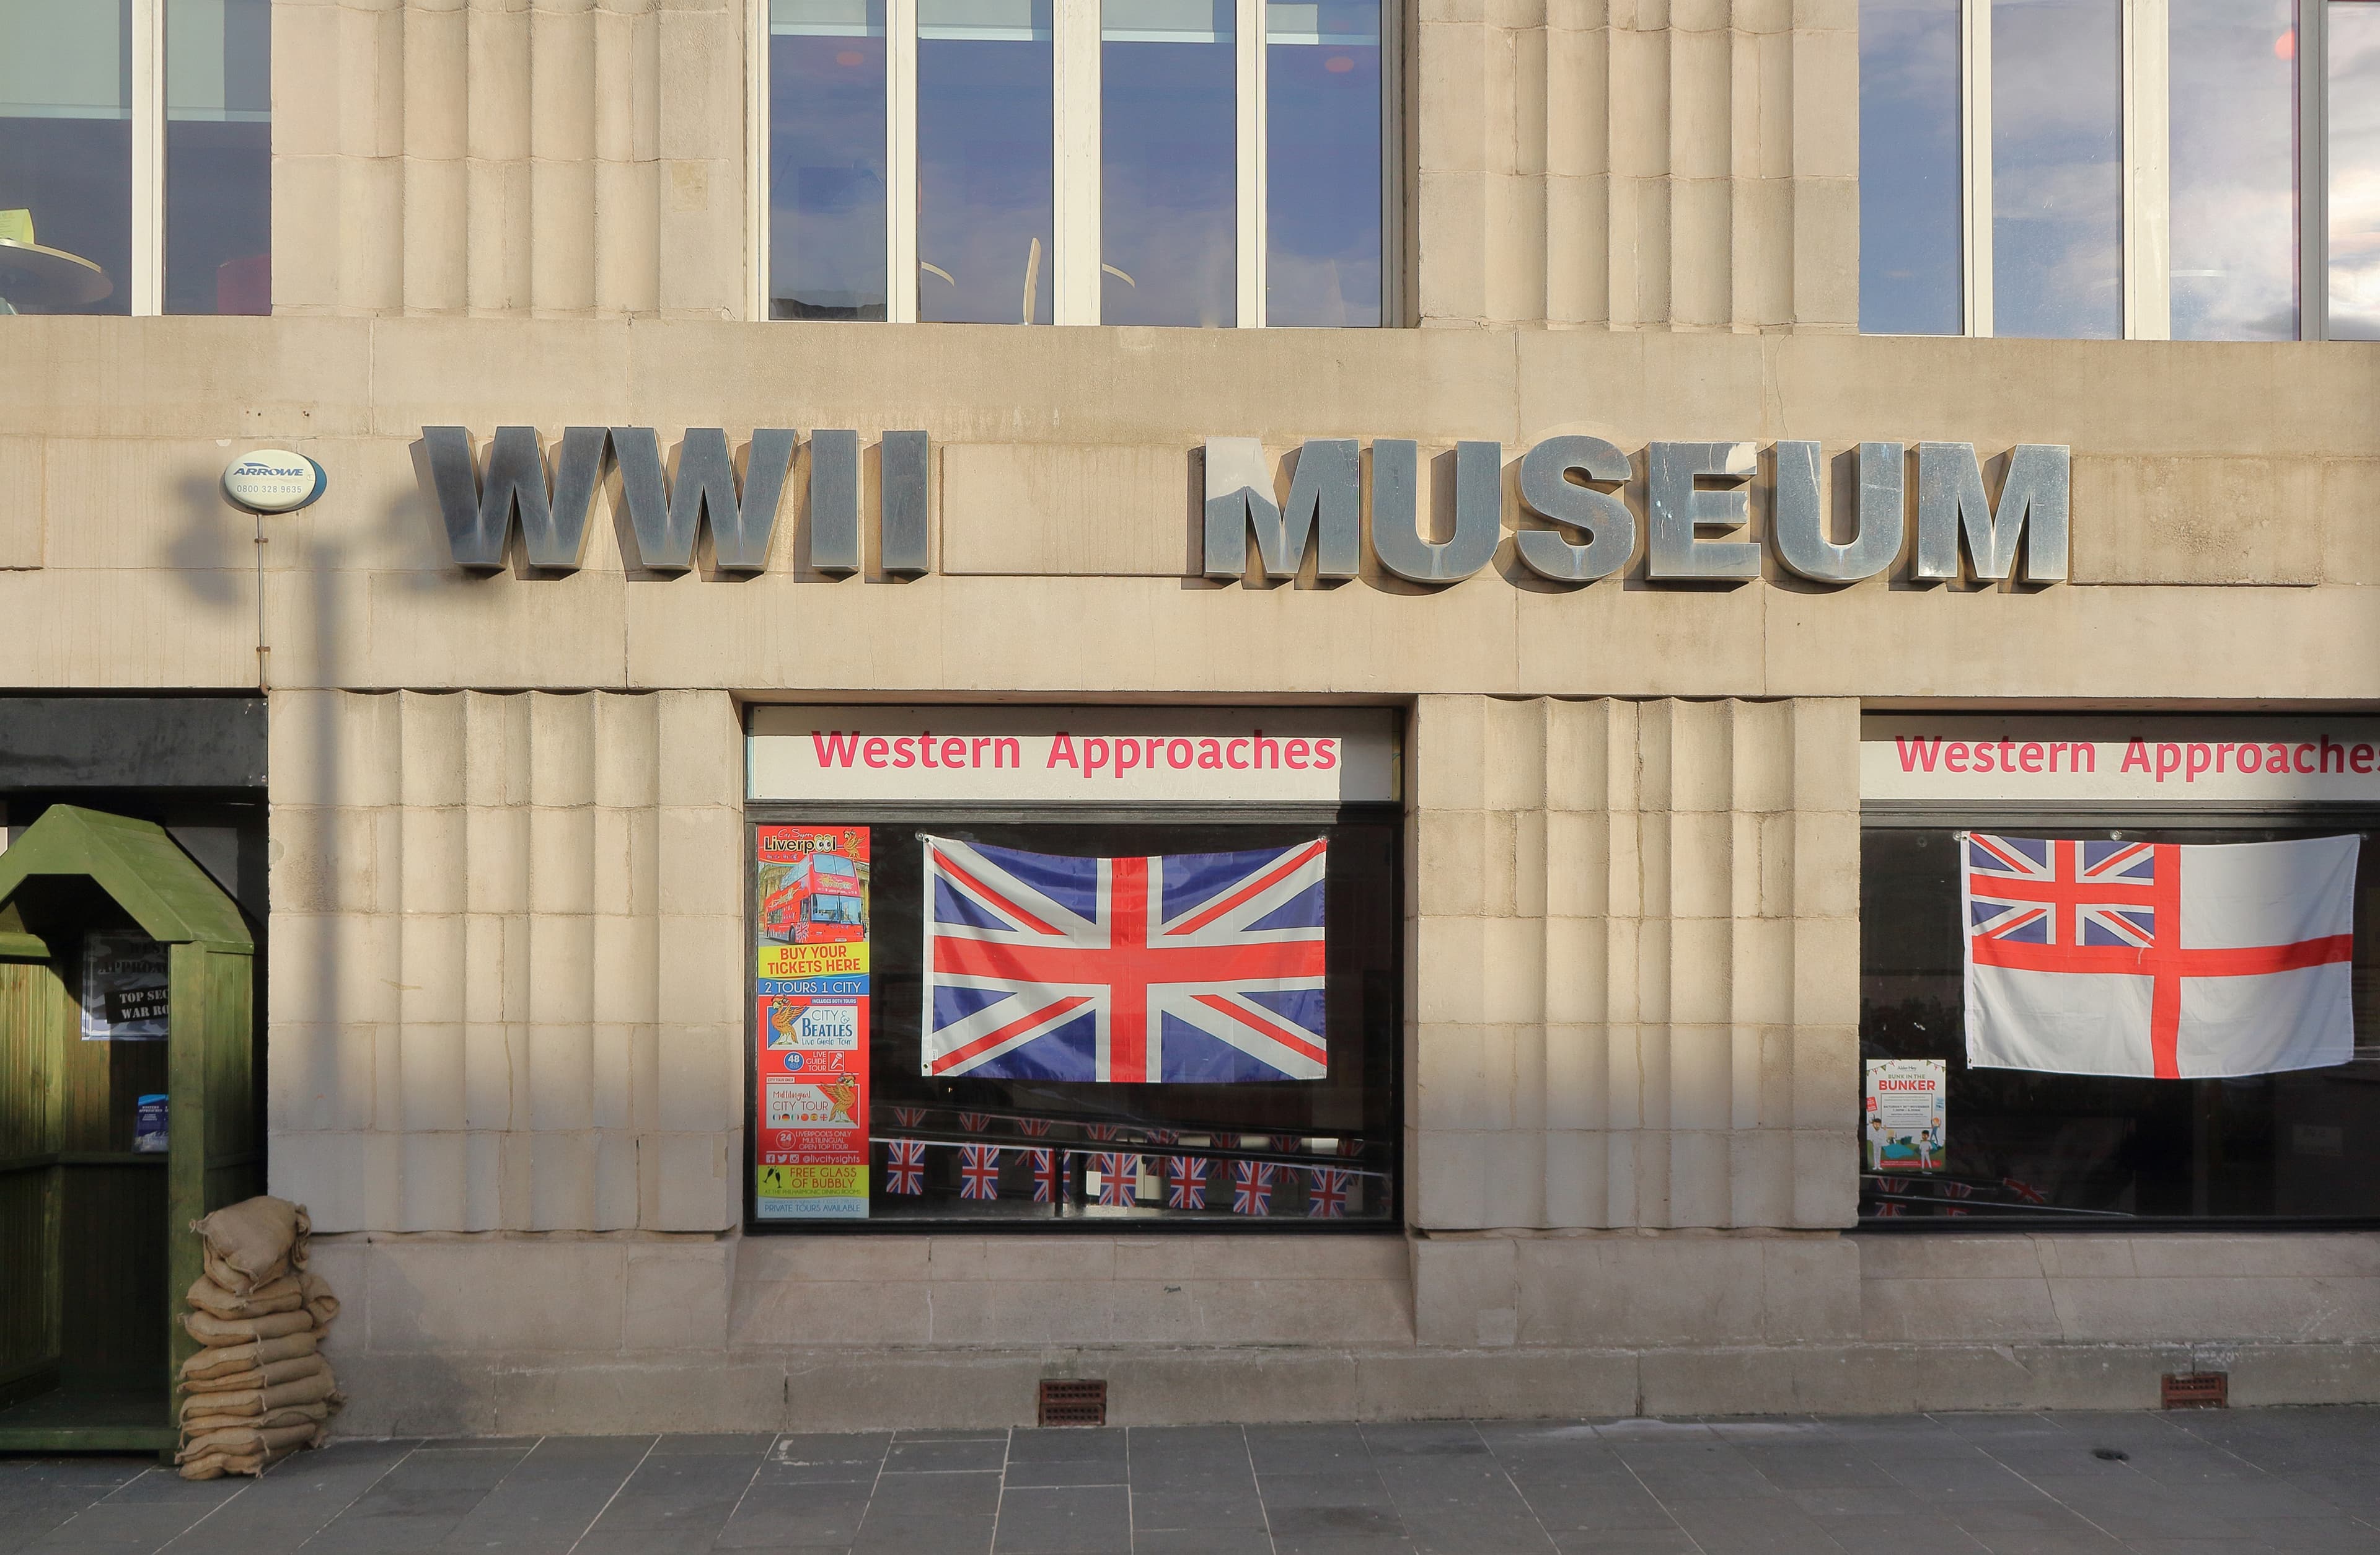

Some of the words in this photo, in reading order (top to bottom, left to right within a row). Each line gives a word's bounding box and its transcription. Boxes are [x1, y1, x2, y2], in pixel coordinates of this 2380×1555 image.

[233, 467, 304, 476] ARROWE
[237, 485, 258, 493] 0800
[262, 485, 278, 493] 328
[281, 485, 302, 493] 9635
[421, 426, 930, 573] WWII
[1205, 435, 2070, 584] MUSEUM
[811, 730, 1020, 769] Western
[1046, 729, 1336, 778] Approaches
[1895, 735, 2096, 773] Western
[2120, 734, 2380, 783] Approache
[764, 834, 837, 855] Liverpool
[780, 947, 808, 961] BUY
[811, 945, 847, 959] YOUR
[767, 960, 822, 975] TICKETS
[826, 958, 861, 972] HERE
[764, 982, 772, 993] 2
[776, 982, 818, 993] TOURS
[821, 982, 829, 993] 1
[832, 982, 862, 993] CITY
[120, 992, 144, 1004] TOP
[122, 1007, 150, 1020] WAR
[811, 1010, 839, 1021] CITY
[840, 1010, 850, 1024] &
[802, 1018, 853, 1037] BEATLES
[802, 1037, 814, 1046] Live
[816, 1037, 834, 1046] Guide
[838, 1037, 852, 1046] Tour
[788, 1055, 800, 1063] 48
[1879, 1080, 1936, 1090] BUNKER
[773, 1091, 811, 1101] Multilingual
[772, 1101, 796, 1111] CITY
[801, 1101, 829, 1111] TOUR
[780, 1134, 791, 1142] 24
[803, 1155, 860, 1164] @livcitysights
[790, 1168, 816, 1178] FREE
[820, 1167, 857, 1178] GLASS
[792, 1178, 809, 1188] OF
[812, 1178, 855, 1188] BUBBLY
[764, 1204, 793, 1212] PRIVATE
[795, 1204, 821, 1212] TOURS
[822, 1204, 860, 1212] AVAILABLE
